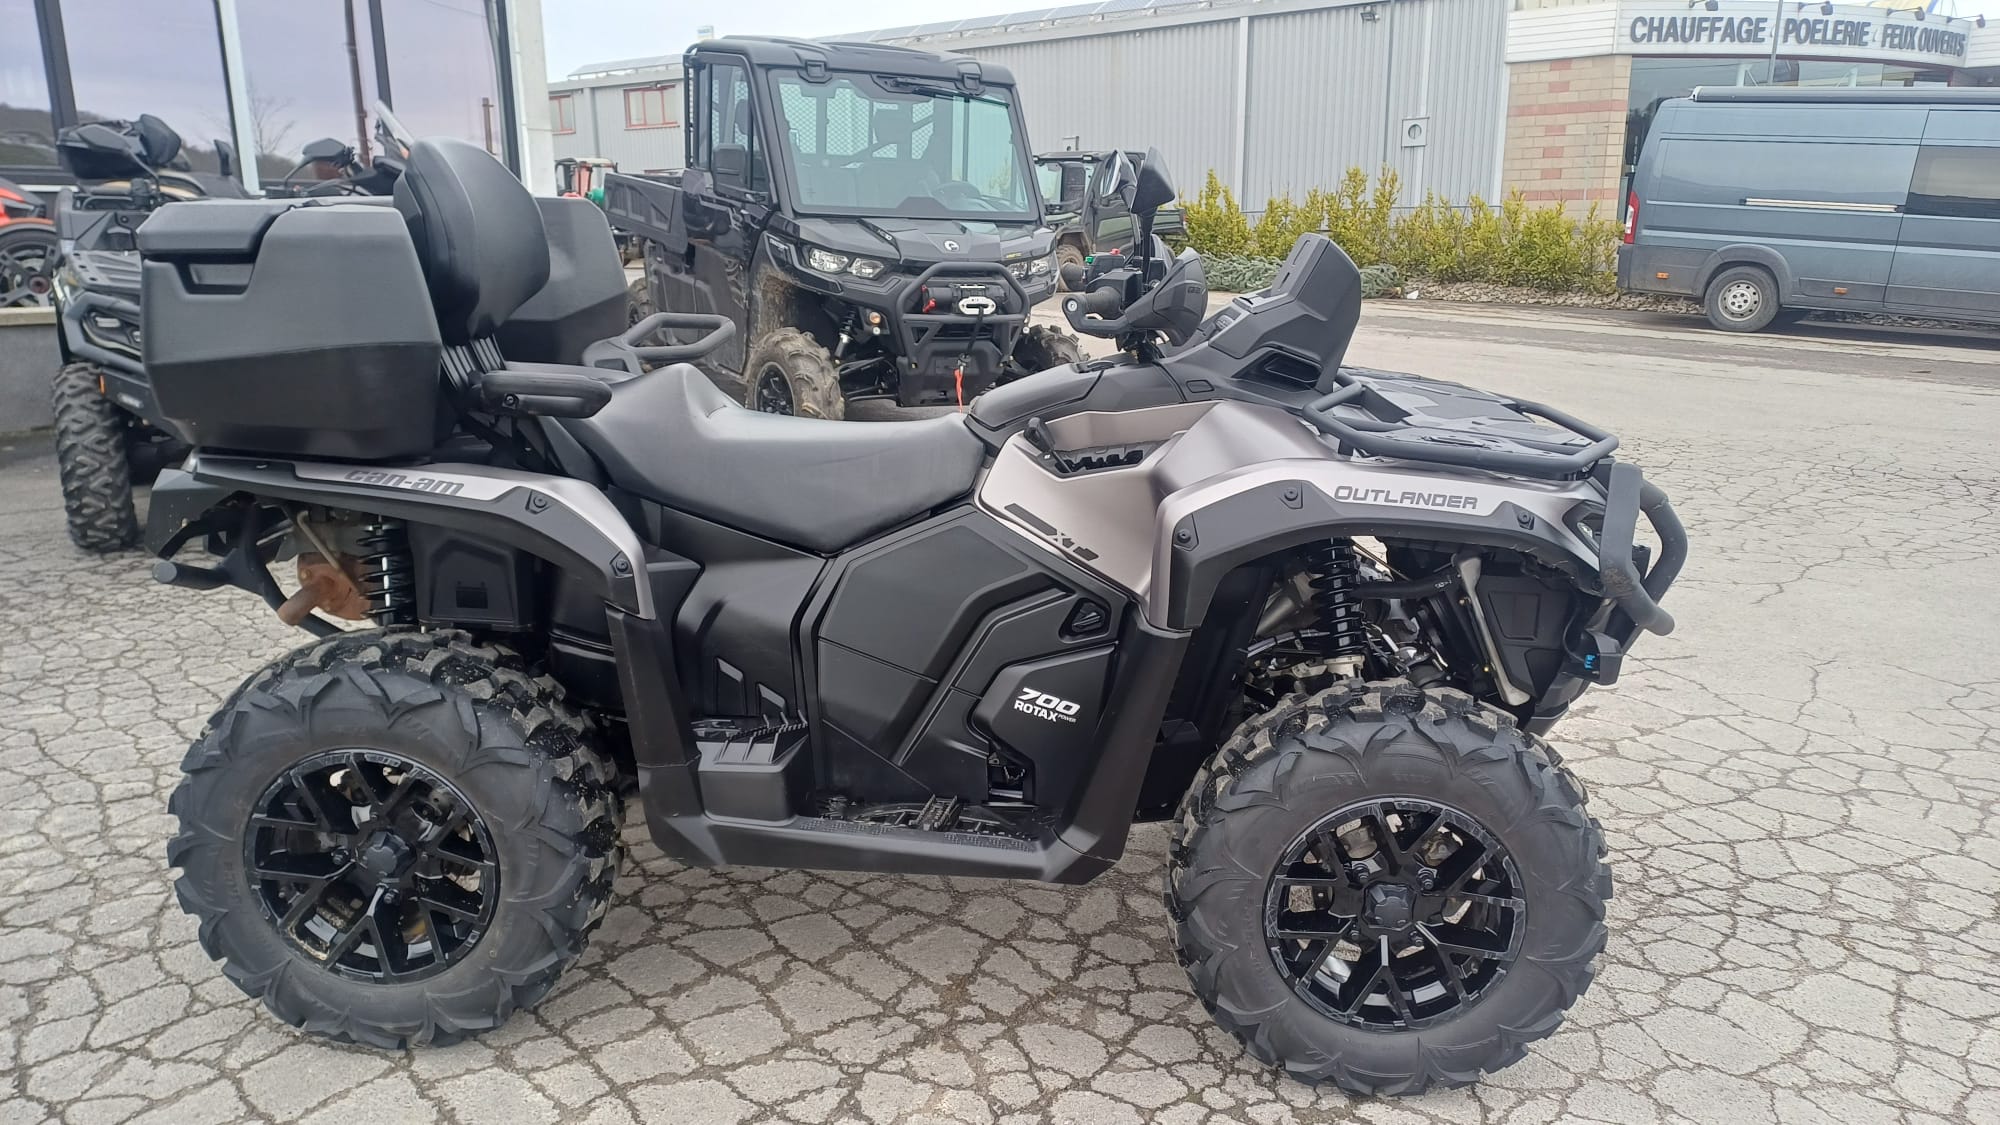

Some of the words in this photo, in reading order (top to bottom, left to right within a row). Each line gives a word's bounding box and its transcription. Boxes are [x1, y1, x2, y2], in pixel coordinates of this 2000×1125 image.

[1630, 16, 1768, 43] CHAUFFAGE
[1783, 18, 1871, 47] POELERIE
[1881, 23, 1919, 50] FEUX
[1917, 27, 1966, 57] OUVERTS
[1334, 485, 1478, 510] OUTLANDER
[1013, 699, 1059, 723] ROTAX
[1017, 687, 1081, 716] 700
